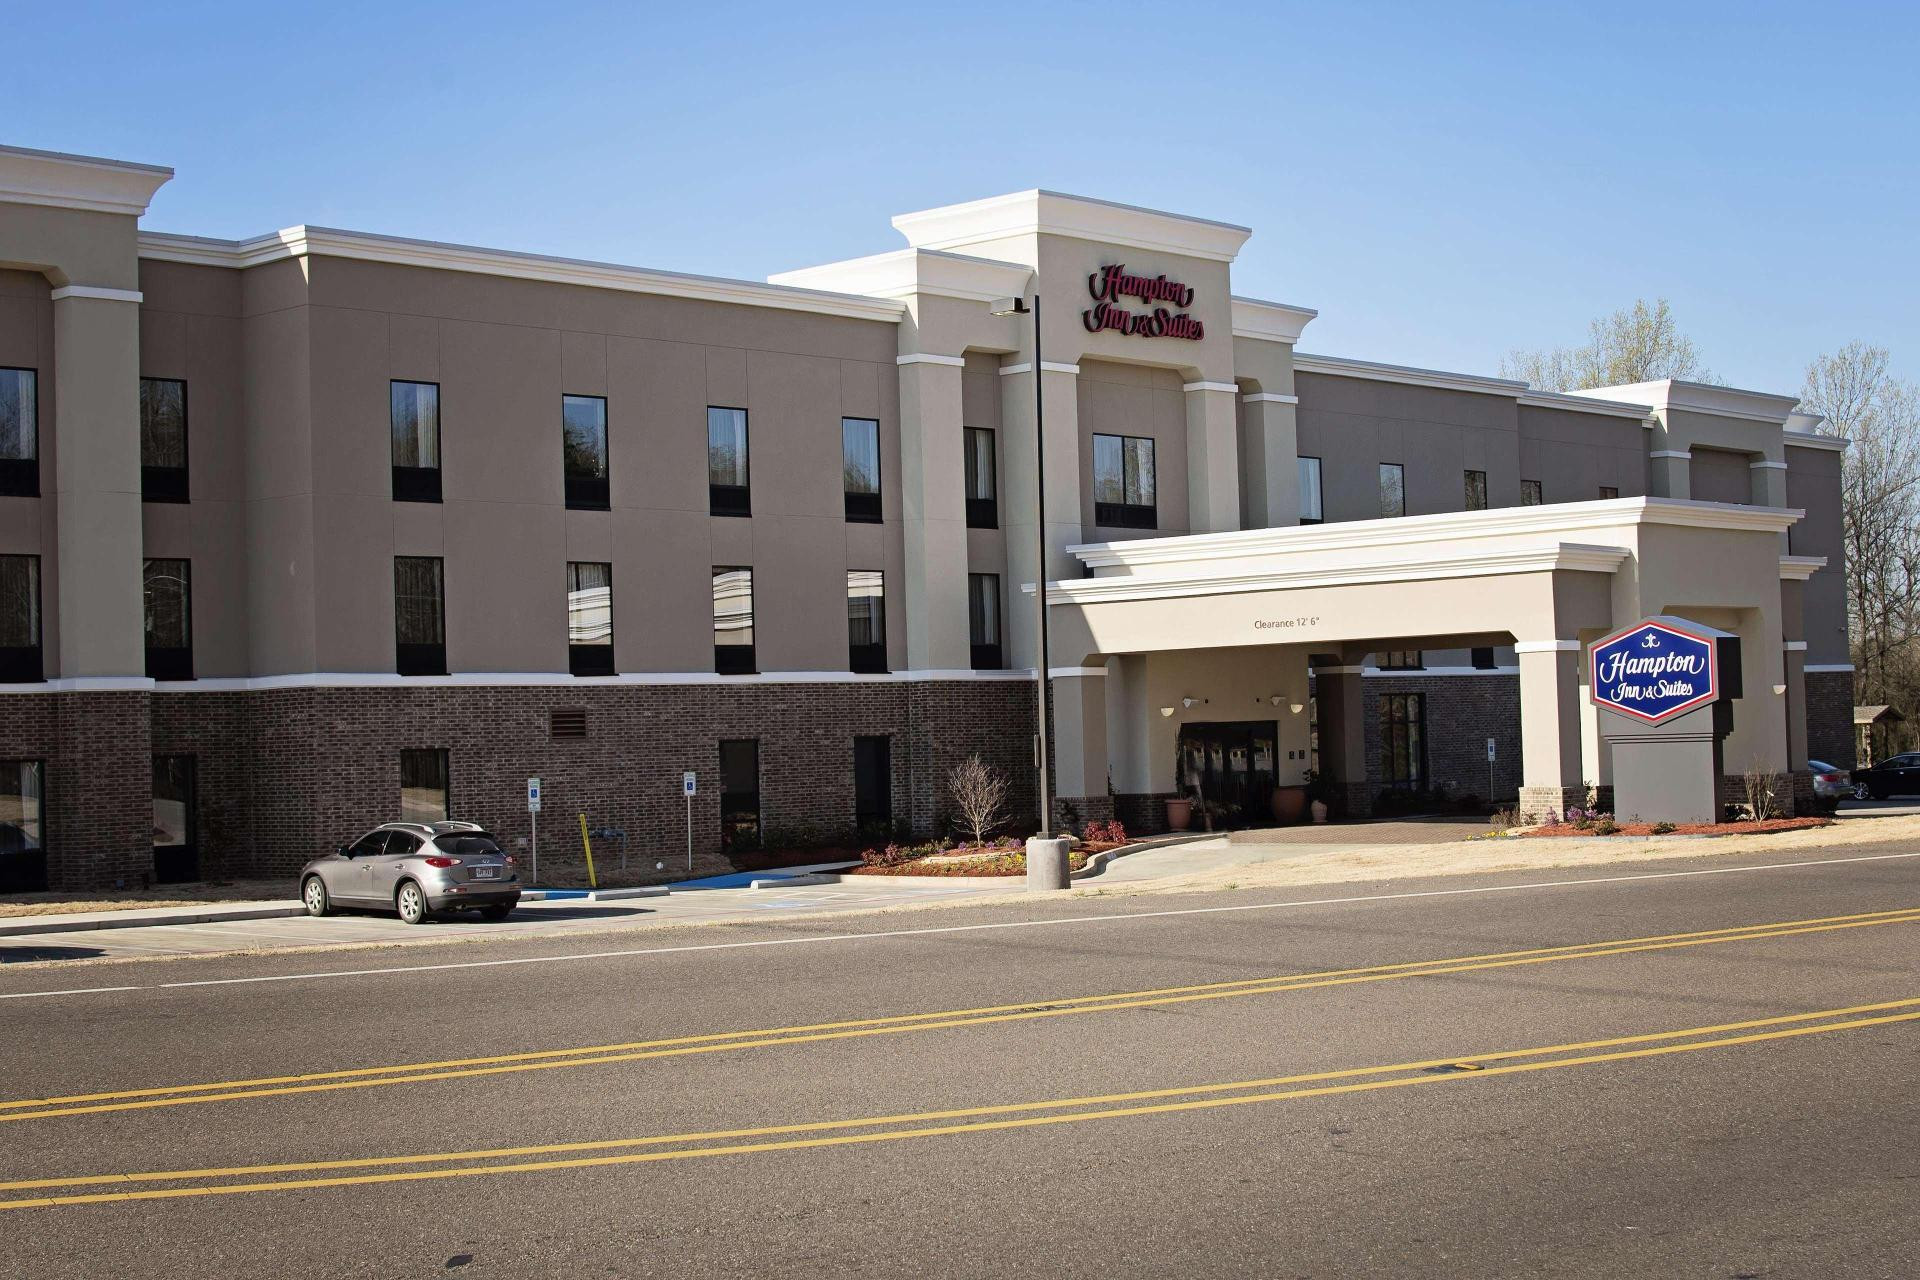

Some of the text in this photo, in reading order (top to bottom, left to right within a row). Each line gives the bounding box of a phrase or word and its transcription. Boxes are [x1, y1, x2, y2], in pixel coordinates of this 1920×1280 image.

[1089, 264, 1194, 308] Hampton
[1083, 302, 1139, 336] Inn
[1151, 308, 1205, 340] Suites
[1254, 619, 1295, 629] Clearance
[1600, 650, 1705, 683] Hampton
[1610, 680, 1693, 702] Inn & Suites
